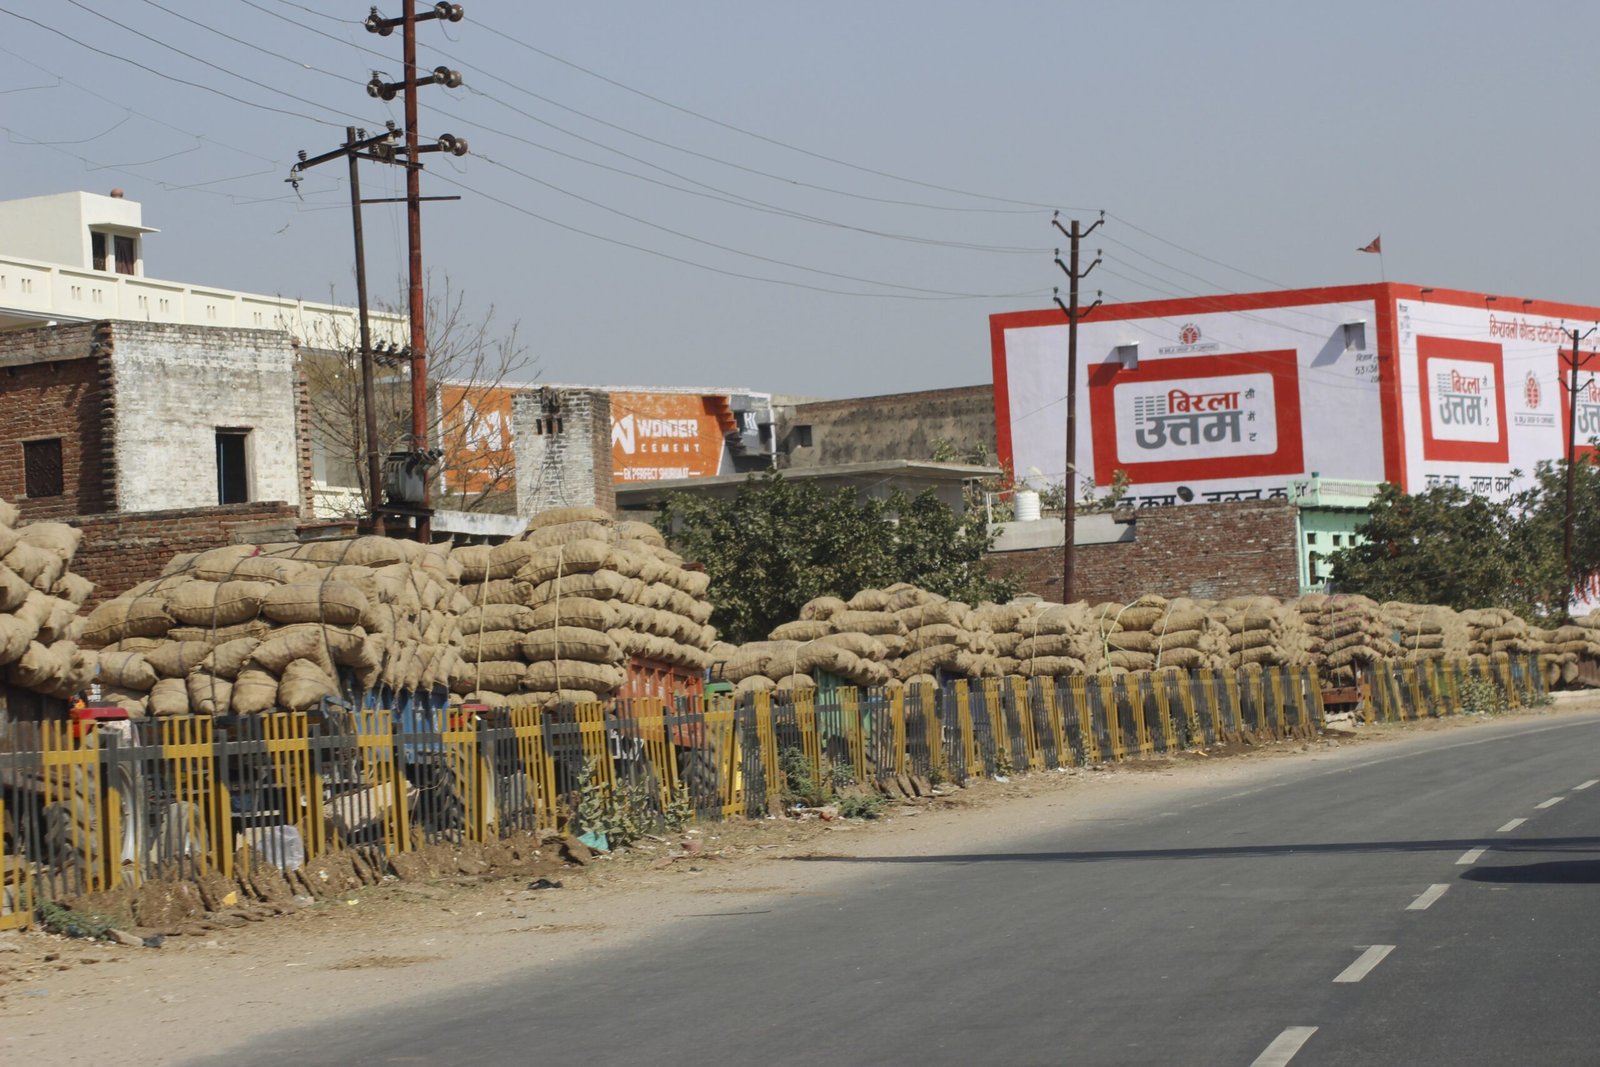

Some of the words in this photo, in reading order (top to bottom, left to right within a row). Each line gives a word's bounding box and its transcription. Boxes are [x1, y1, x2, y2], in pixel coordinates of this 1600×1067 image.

[1451, 369, 1480, 395] बिरला
[1168, 389, 1240, 413] बिरला
[1440, 394, 1482, 425] उत्तम
[637, 419, 698, 437] WONDER
[1136, 411, 1243, 450] उत्तम
[641, 443, 699, 453] CEMENT
[1469, 476, 1492, 494] जलन
[1494, 477, 1511, 494] कम
